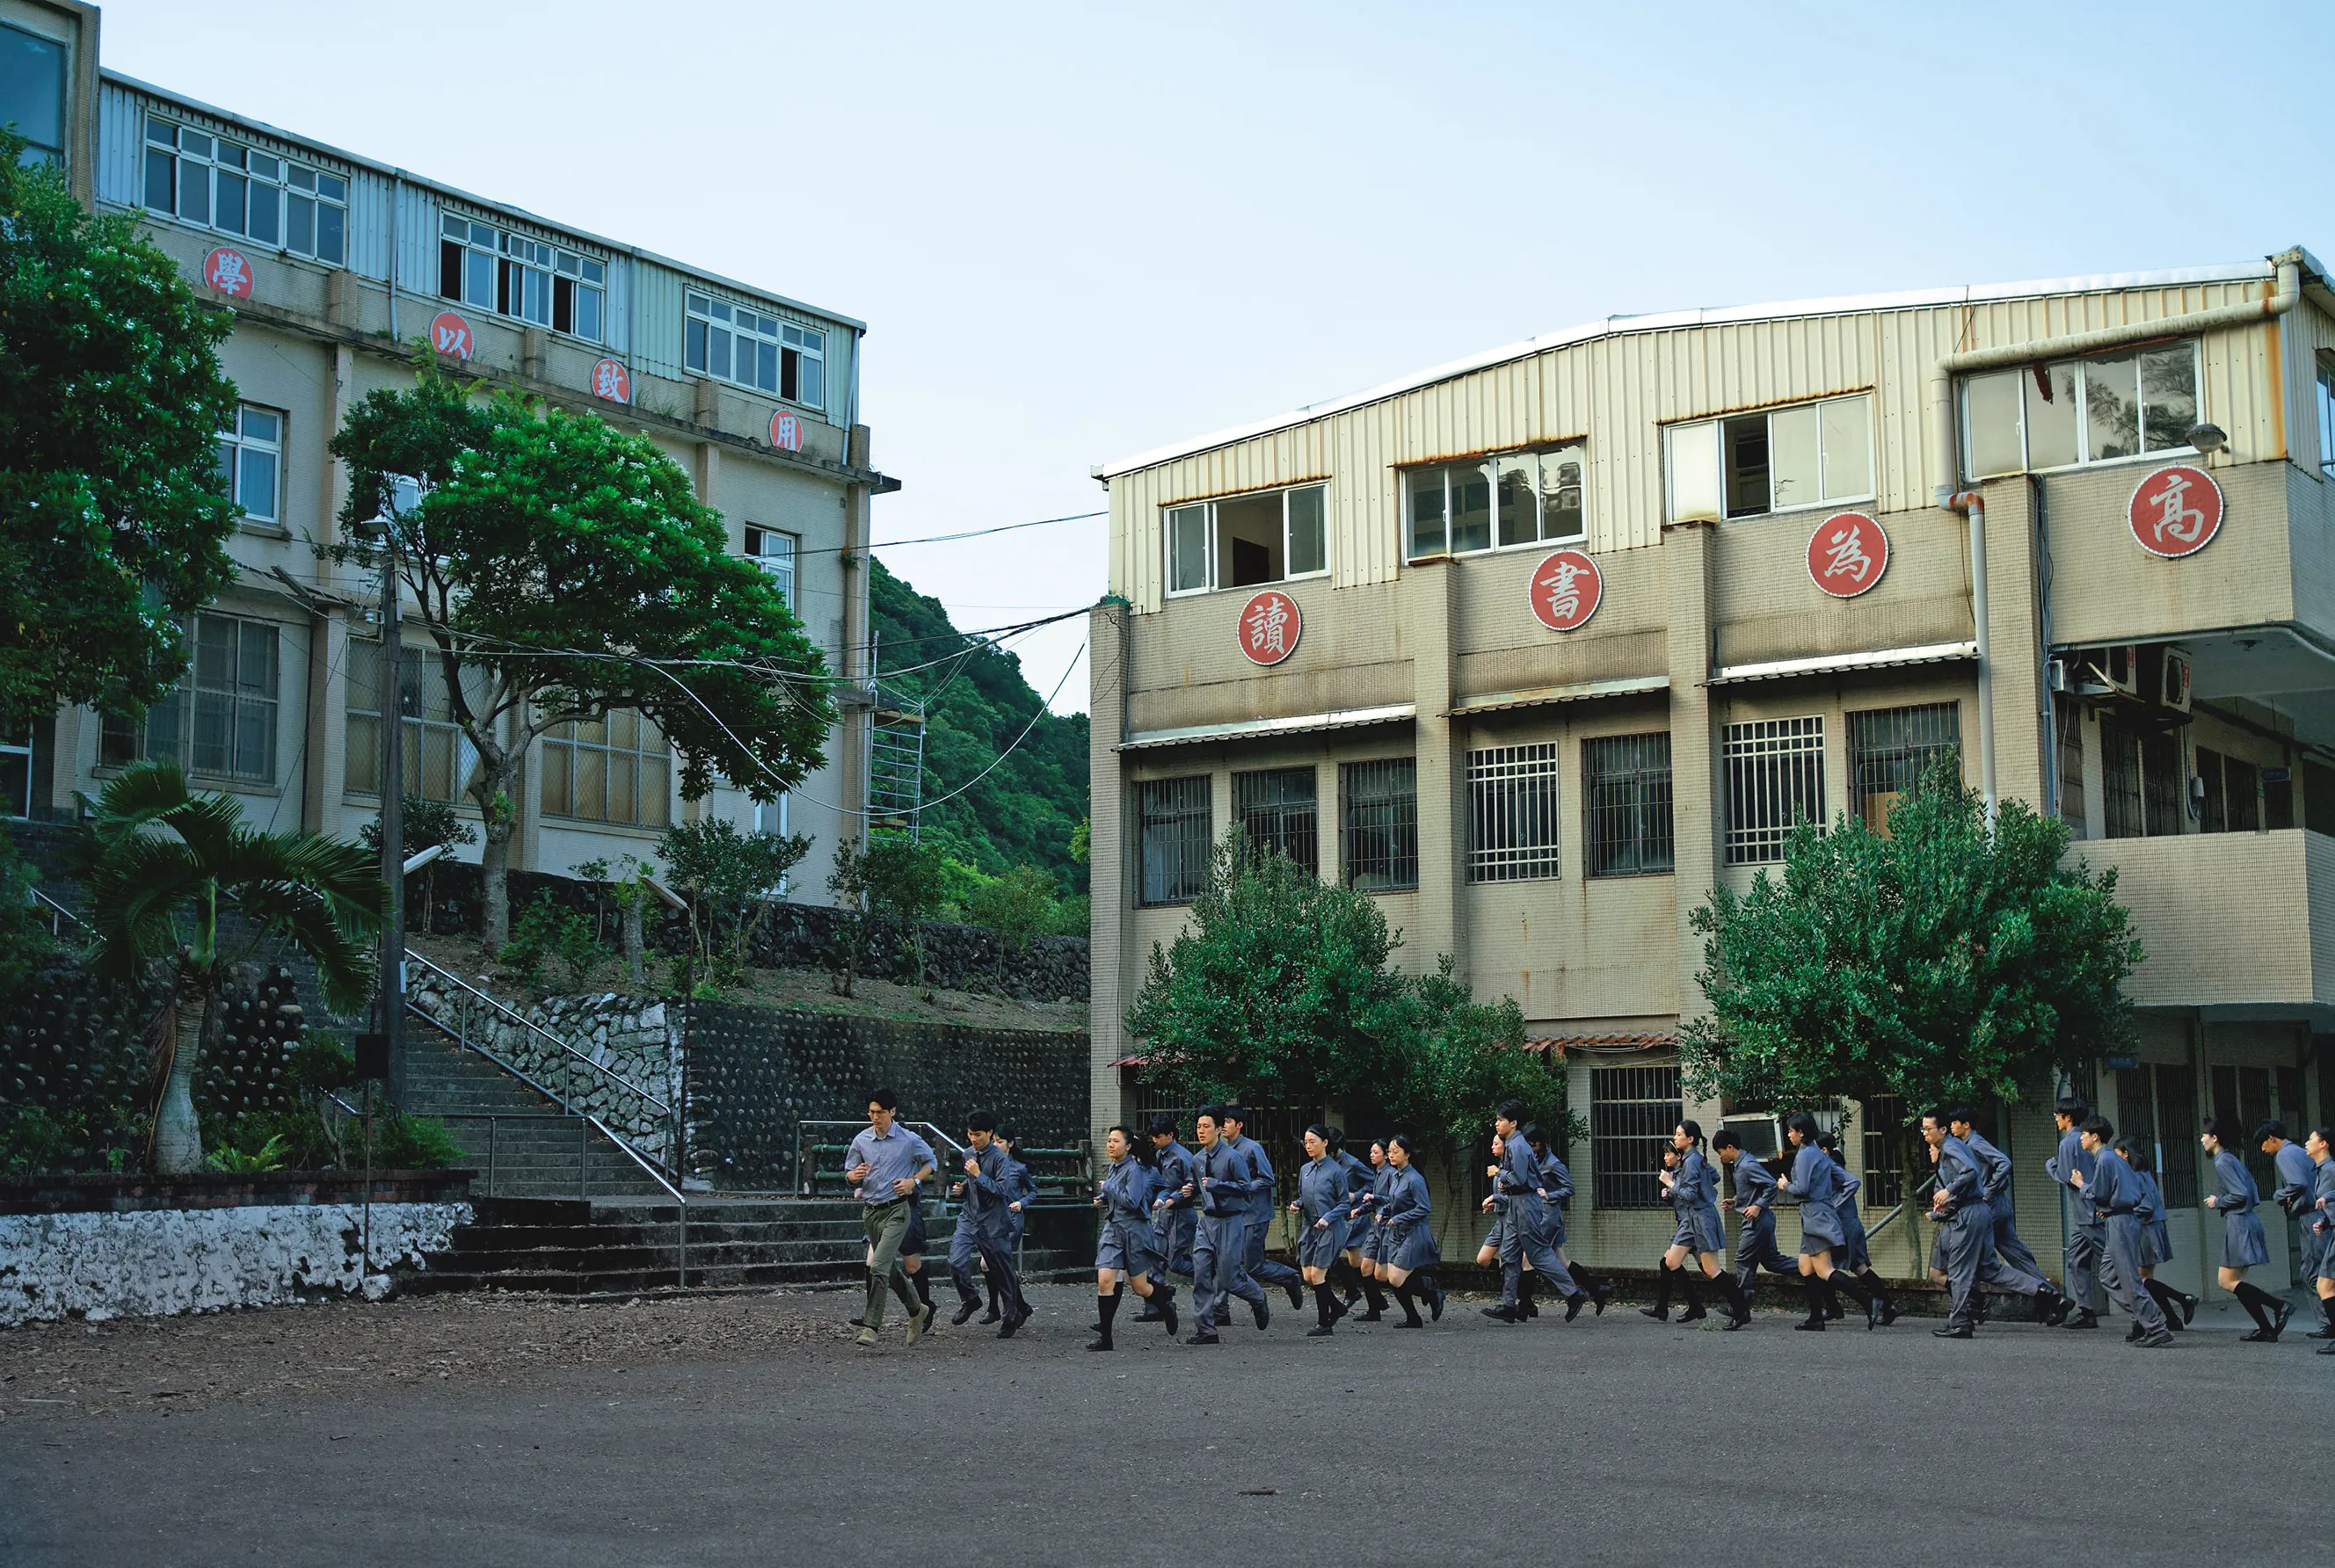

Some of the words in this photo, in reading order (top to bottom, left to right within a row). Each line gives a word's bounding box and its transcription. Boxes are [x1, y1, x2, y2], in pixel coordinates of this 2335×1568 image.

[213, 253, 246, 295] 學
[438, 325, 466, 359] 以
[600, 364, 624, 403] 致
[777, 417, 797, 450] 用
[1247, 597, 1288, 654] 讀
[1540, 561, 1590, 619] 書
[1825, 524, 1871, 582] 為
[2150, 475, 2204, 542] 高
